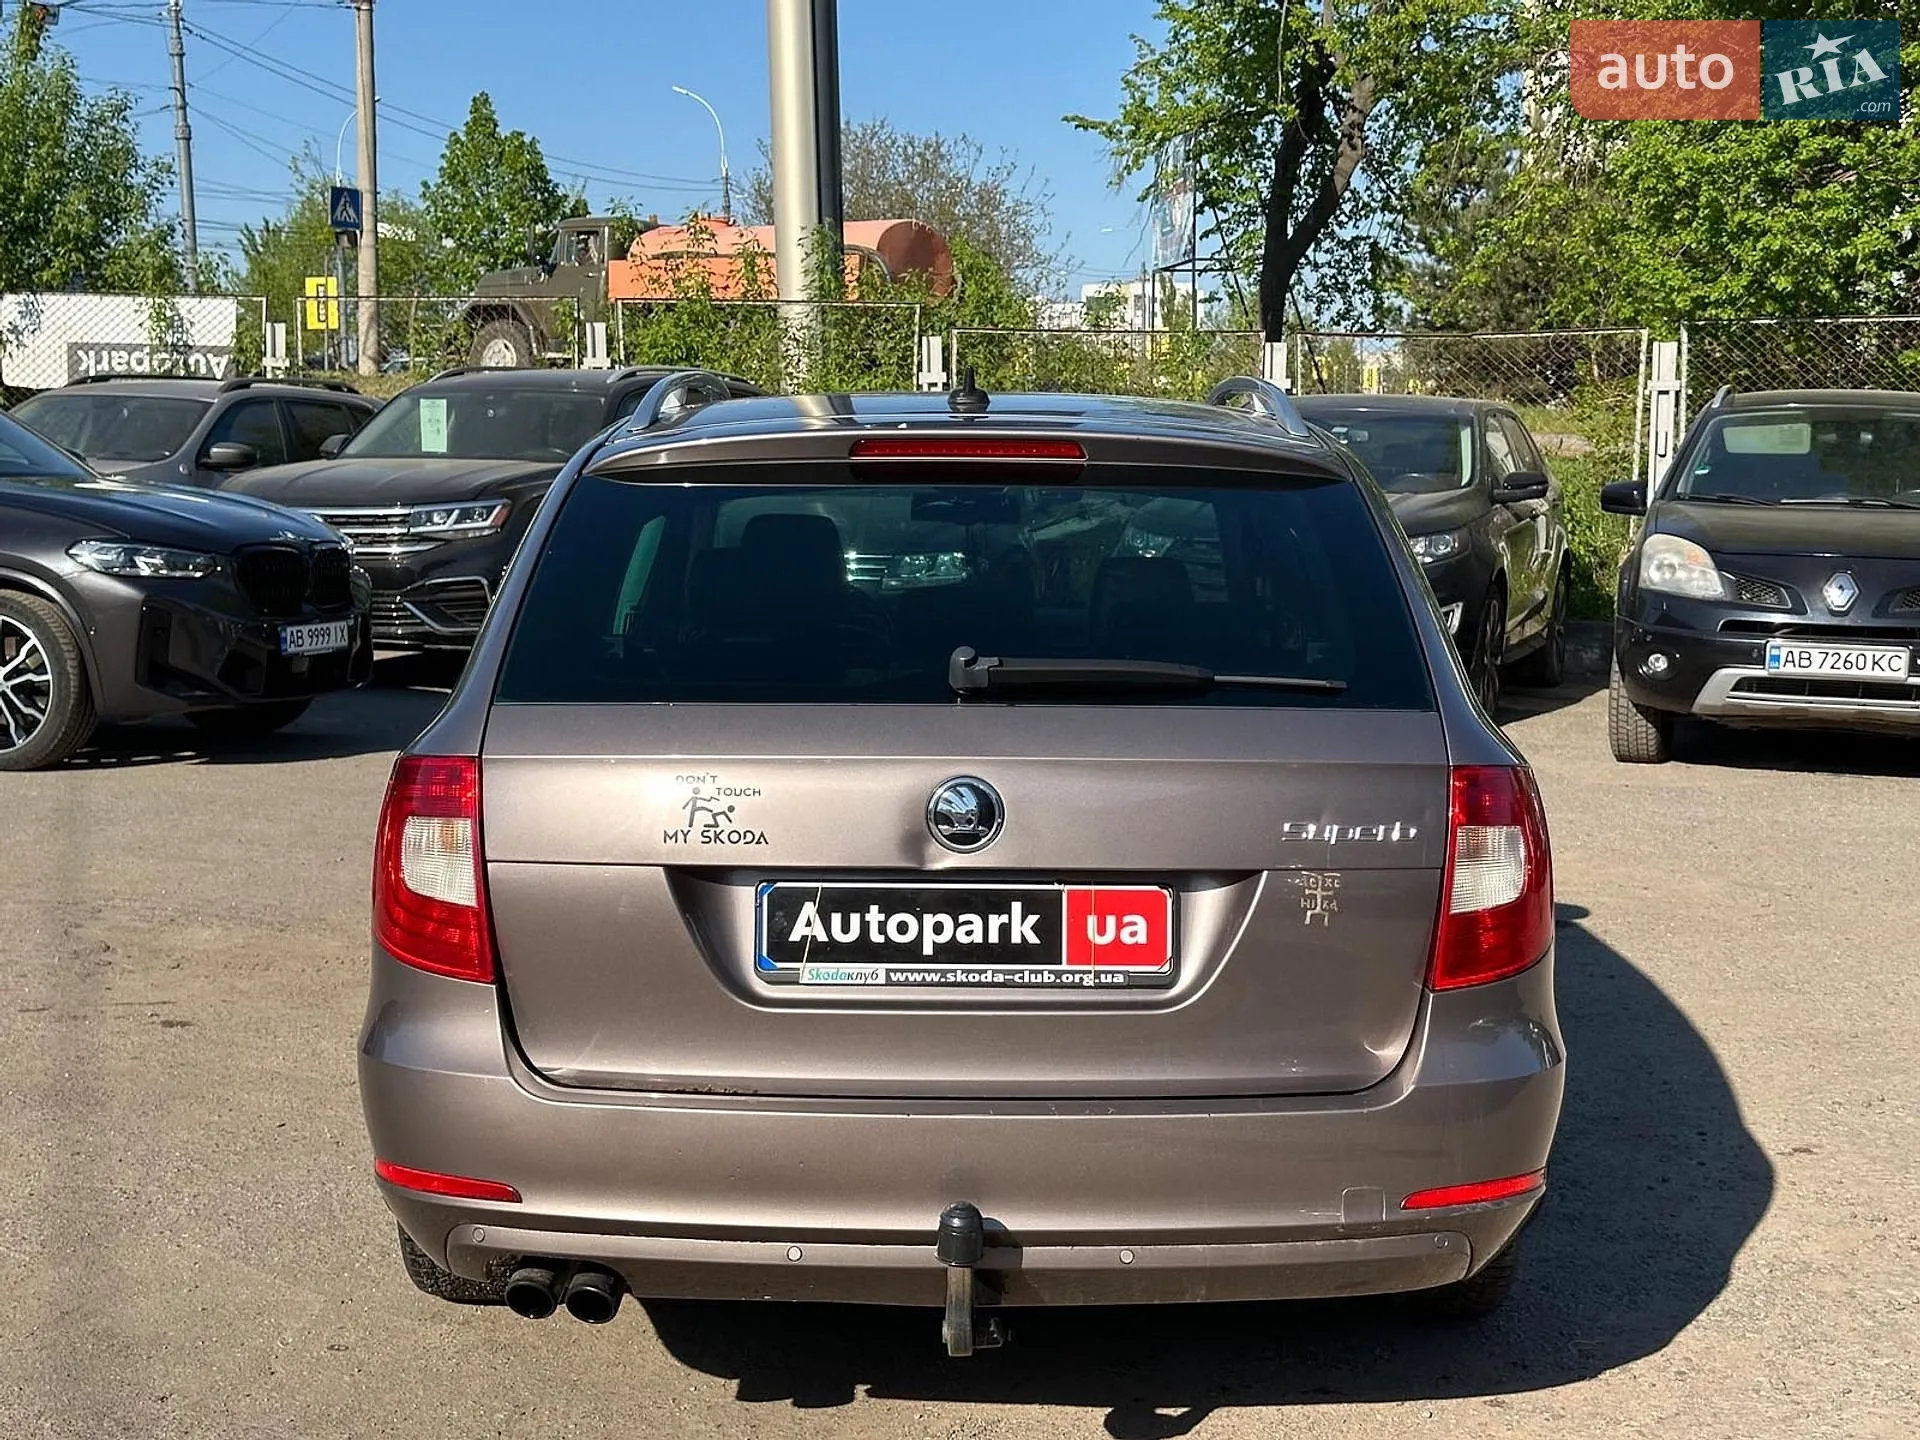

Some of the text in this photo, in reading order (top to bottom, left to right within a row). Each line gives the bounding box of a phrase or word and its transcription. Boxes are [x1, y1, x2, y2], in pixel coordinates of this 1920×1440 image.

[289, 624, 347, 649] AB 9999 IX
[1783, 650, 1902, 672] AB 7260 KC
[675, 772, 718, 784] DON'T
[715, 787, 761, 797] TOUCH
[663, 829, 769, 845] MY SKODA
[1281, 820, 1418, 845] Superb
[788, 901, 1148, 956] Autopark ua
[889, 969, 1125, 987] www.skoda-club.org.ua
